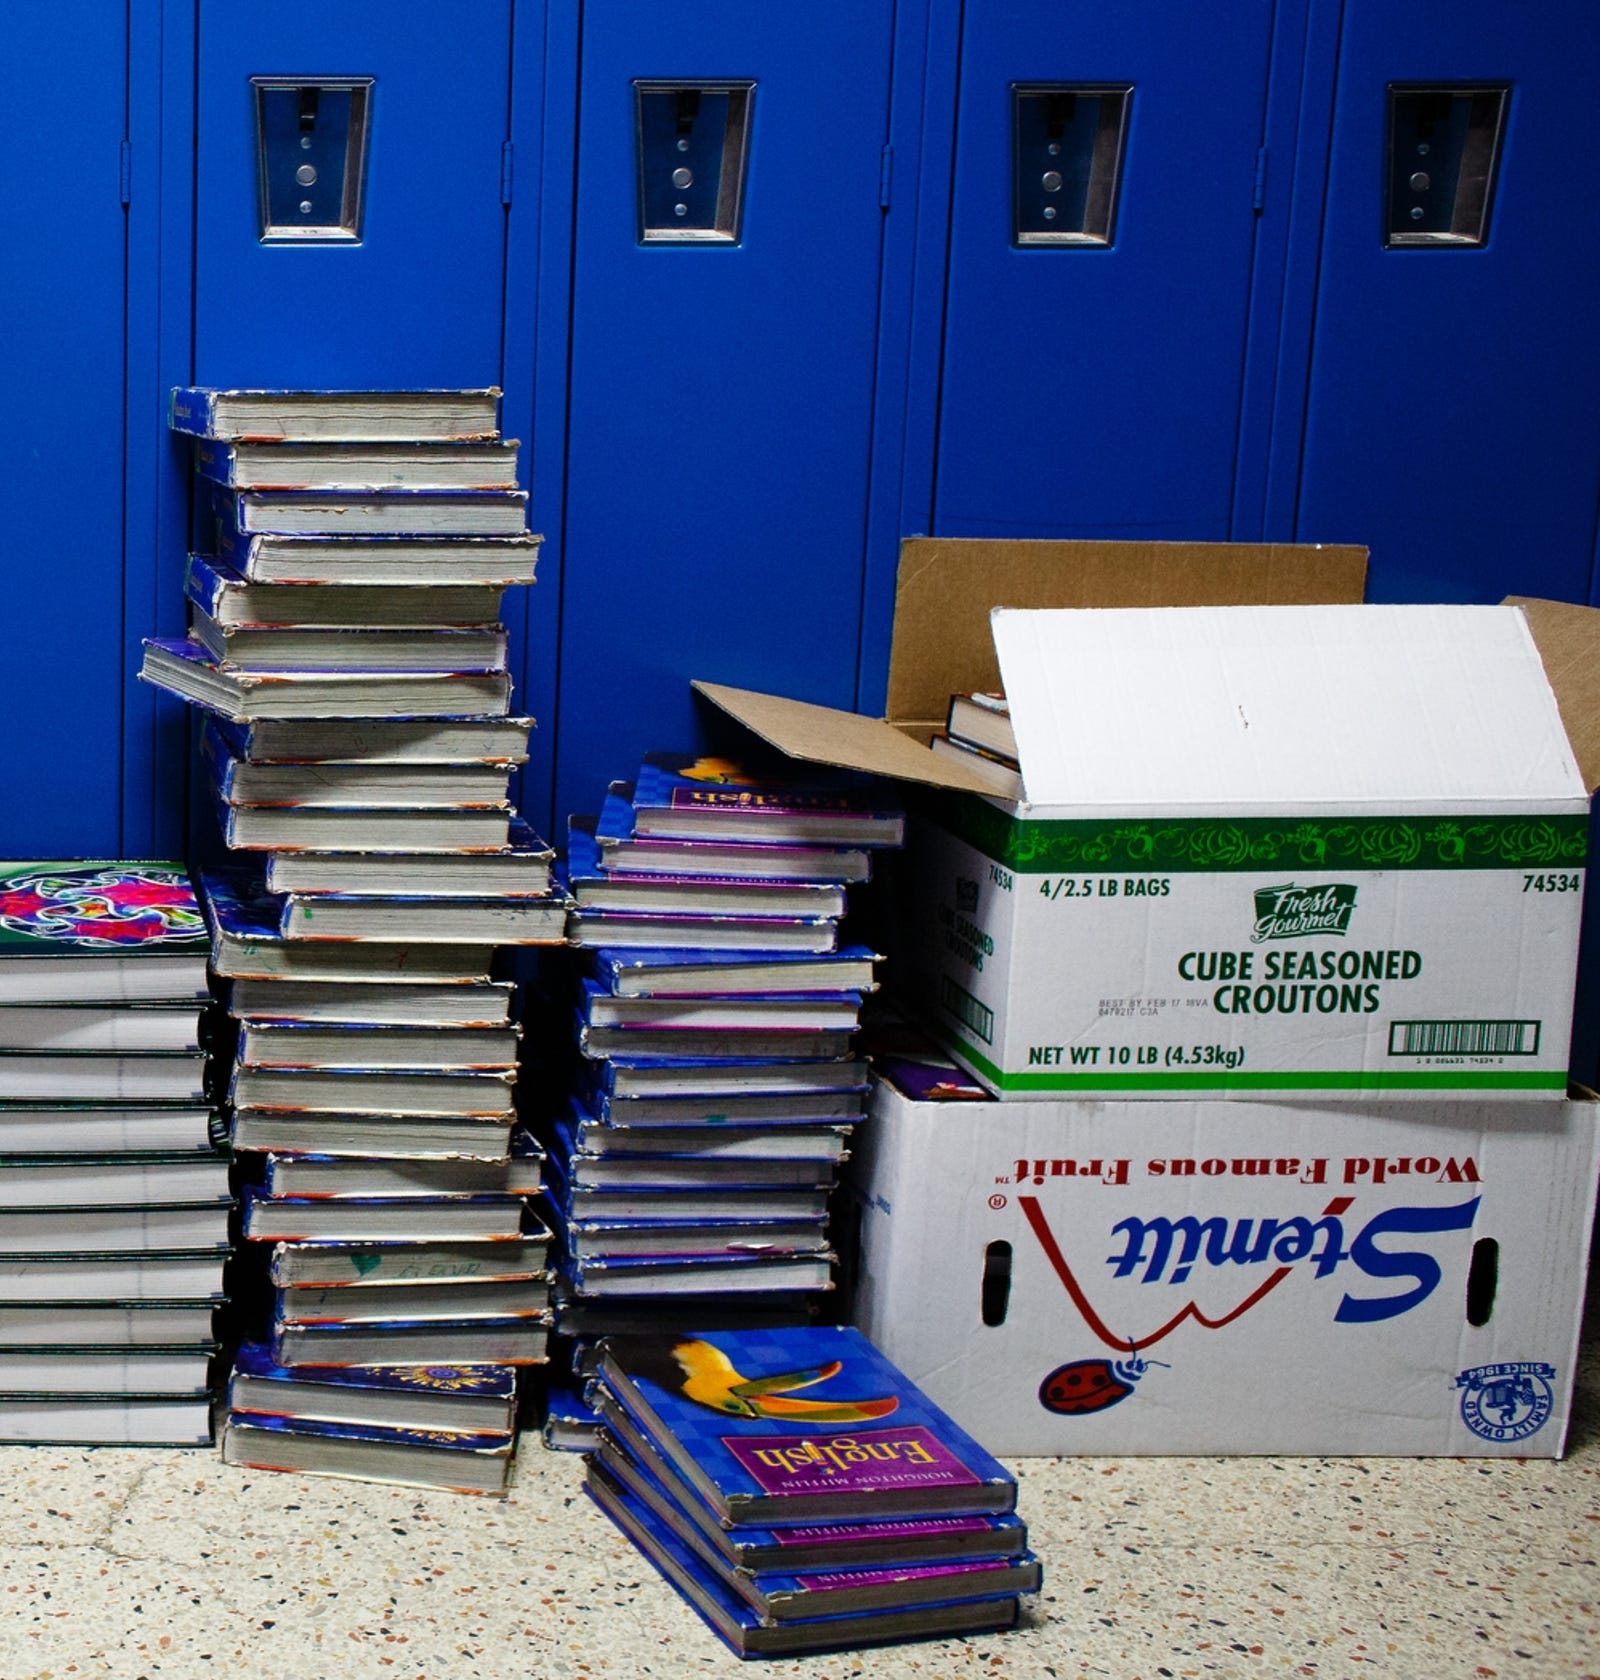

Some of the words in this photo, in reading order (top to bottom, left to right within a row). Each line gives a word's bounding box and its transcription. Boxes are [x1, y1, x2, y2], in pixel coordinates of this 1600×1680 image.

[989, 865, 1013, 893] 74534
[1040, 879, 1093, 900] 4/2.5
[1099, 879, 1118, 897] LB
[1123, 878, 1171, 897] BAGS
[1522, 875, 1580, 892] 74534
[1273, 886, 1339, 915] Fresh
[1251, 903, 1357, 944] Gourmet
[1178, 952, 1253, 981] CUBE
[1264, 951, 1422, 980] SEASONED
[1098, 999, 1123, 1008] BEST
[1129, 999, 1142, 1008] BY
[1146, 999, 1167, 1008] FEB
[1213, 984, 1380, 1014] CROUTONS
[1028, 1047, 1064, 1065] NET
[1070, 1047, 1101, 1064] WT
[1108, 1047, 1131, 1064] 10
[1137, 1047, 1158, 1064] LB
[1164, 1046, 1246, 1069] (4.53kg)
[1014, 1158, 1132, 1186] Fruit
[1148, 1157, 1330, 1185] Famous
[1343, 1157, 1484, 1184] World
[1106, 1194, 1482, 1324] Stemilt
[1468, 1365, 1500, 1380] 1964
[1504, 1364, 1543, 1374] SINCE
[1464, 1401, 1505, 1438] OWNED
[1512, 1394, 1548, 1438] FAMILY
[753, 1438, 940, 1474] English
[781, 1477, 850, 1489] MIFFLIN
[855, 1471, 954, 1485] HOUGHTON
[792, 1526, 860, 1538] MIFFLIN
